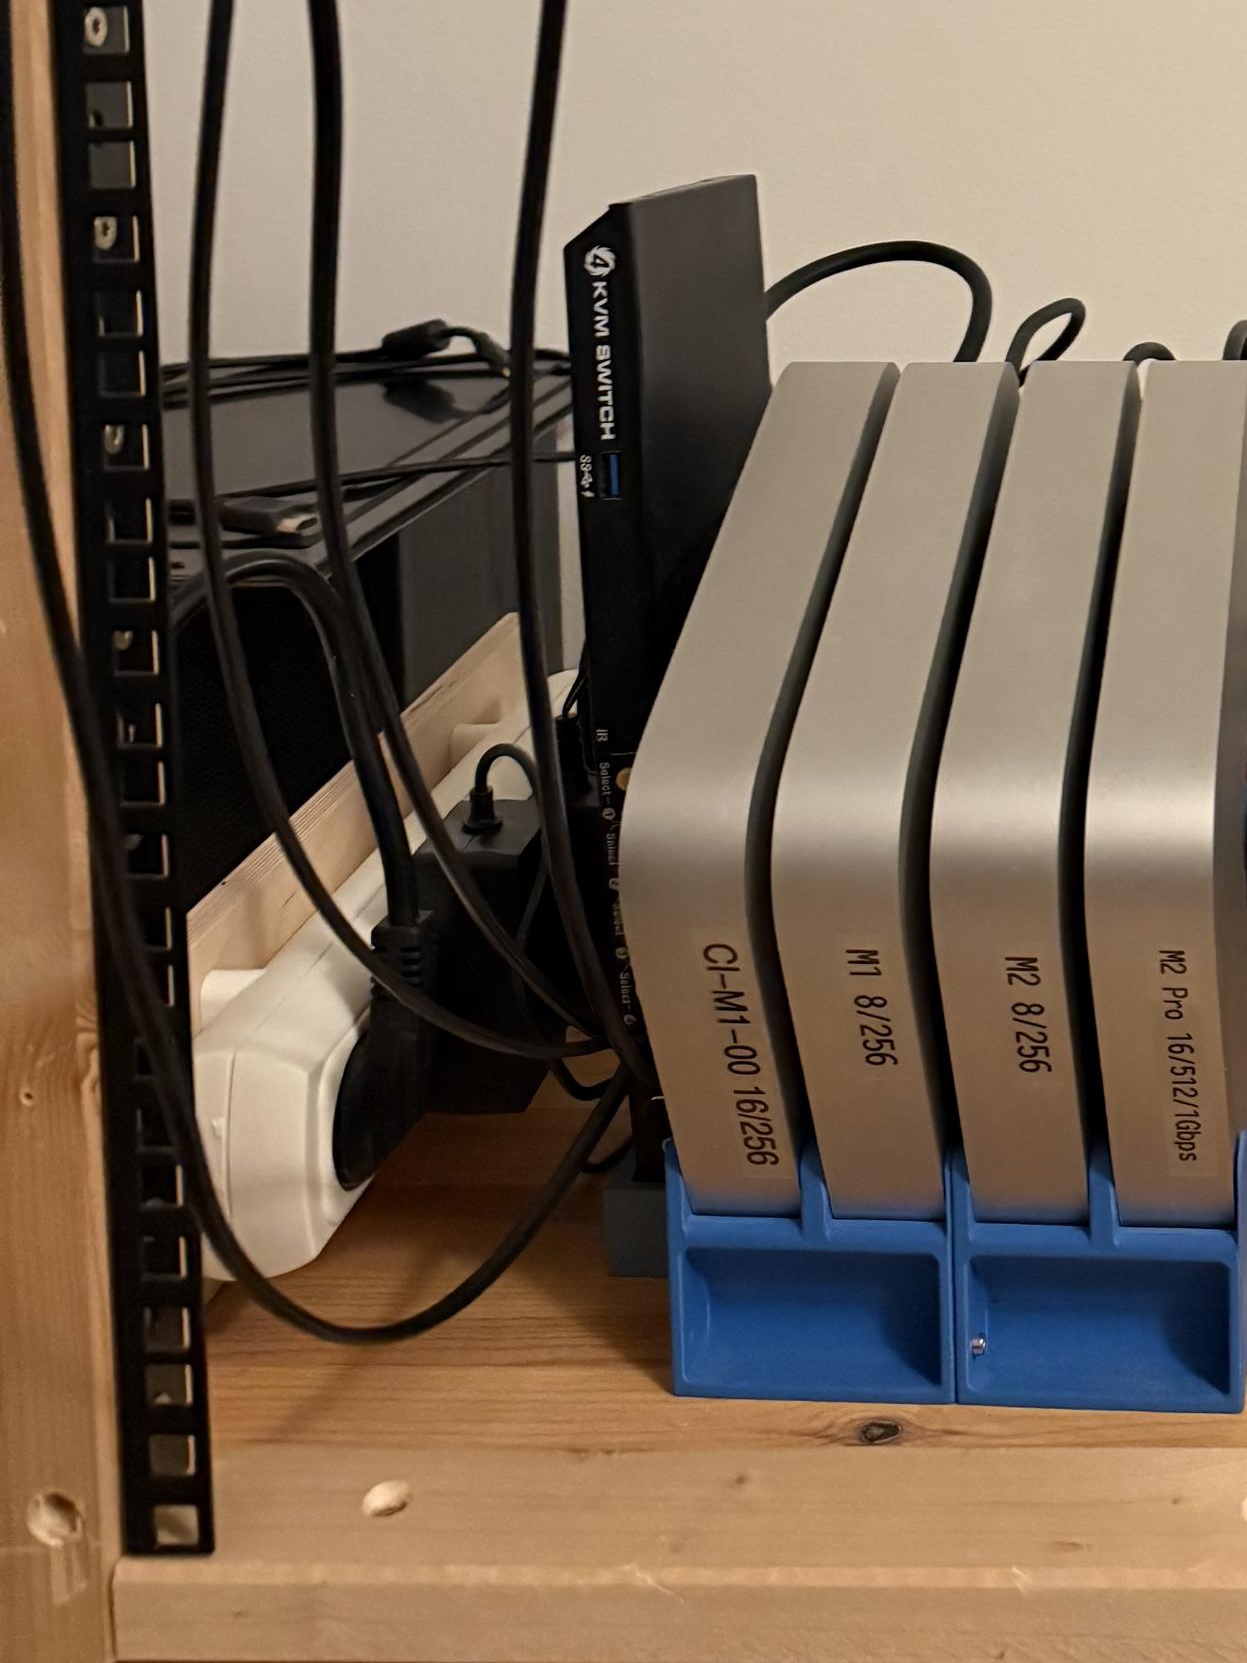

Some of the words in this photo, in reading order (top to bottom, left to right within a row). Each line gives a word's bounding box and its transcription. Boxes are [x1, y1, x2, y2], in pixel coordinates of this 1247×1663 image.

[592, 281, 610, 338] KVM
[595, 344, 616, 441] SWITCH
[845, 949, 882, 977] M1
[1005, 957, 1041, 985] M2
[1158, 950, 1187, 974] M2
[854, 995, 898, 1066] 8/256
[1161, 987, 1189, 1020] Pro
[702, 943, 761, 1075] CI-M1-00
[733, 1086, 779, 1166] 16/256
[1011, 1002, 1052, 1073] 8/256
[1167, 1033, 1202, 1161] 16/512/1Gbps
